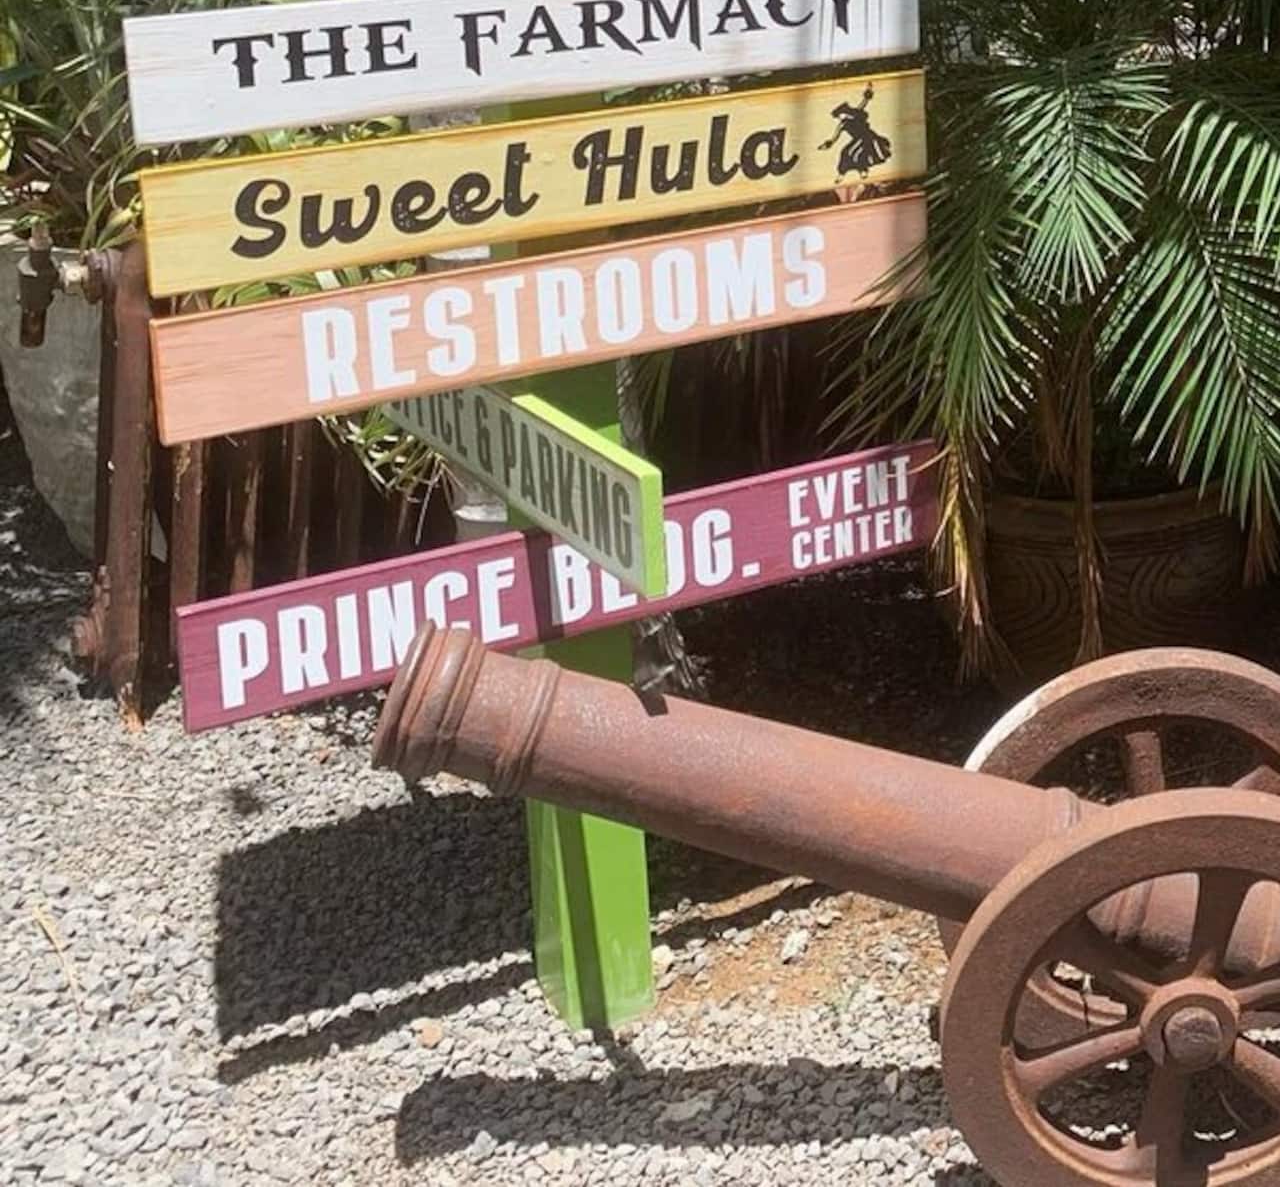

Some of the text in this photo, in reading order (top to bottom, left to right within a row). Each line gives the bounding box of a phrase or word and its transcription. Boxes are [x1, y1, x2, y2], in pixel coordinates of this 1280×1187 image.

[212, 17, 418, 89] THE
[230, 114, 800, 260] Sweet Hula
[302, 226, 827, 404] RESTROOMS
[500, 408, 633, 568] PARKING
[789, 454, 911, 527] EVENT
[793, 506, 913, 570] CENTER
[217, 556, 519, 710] PRINCE
